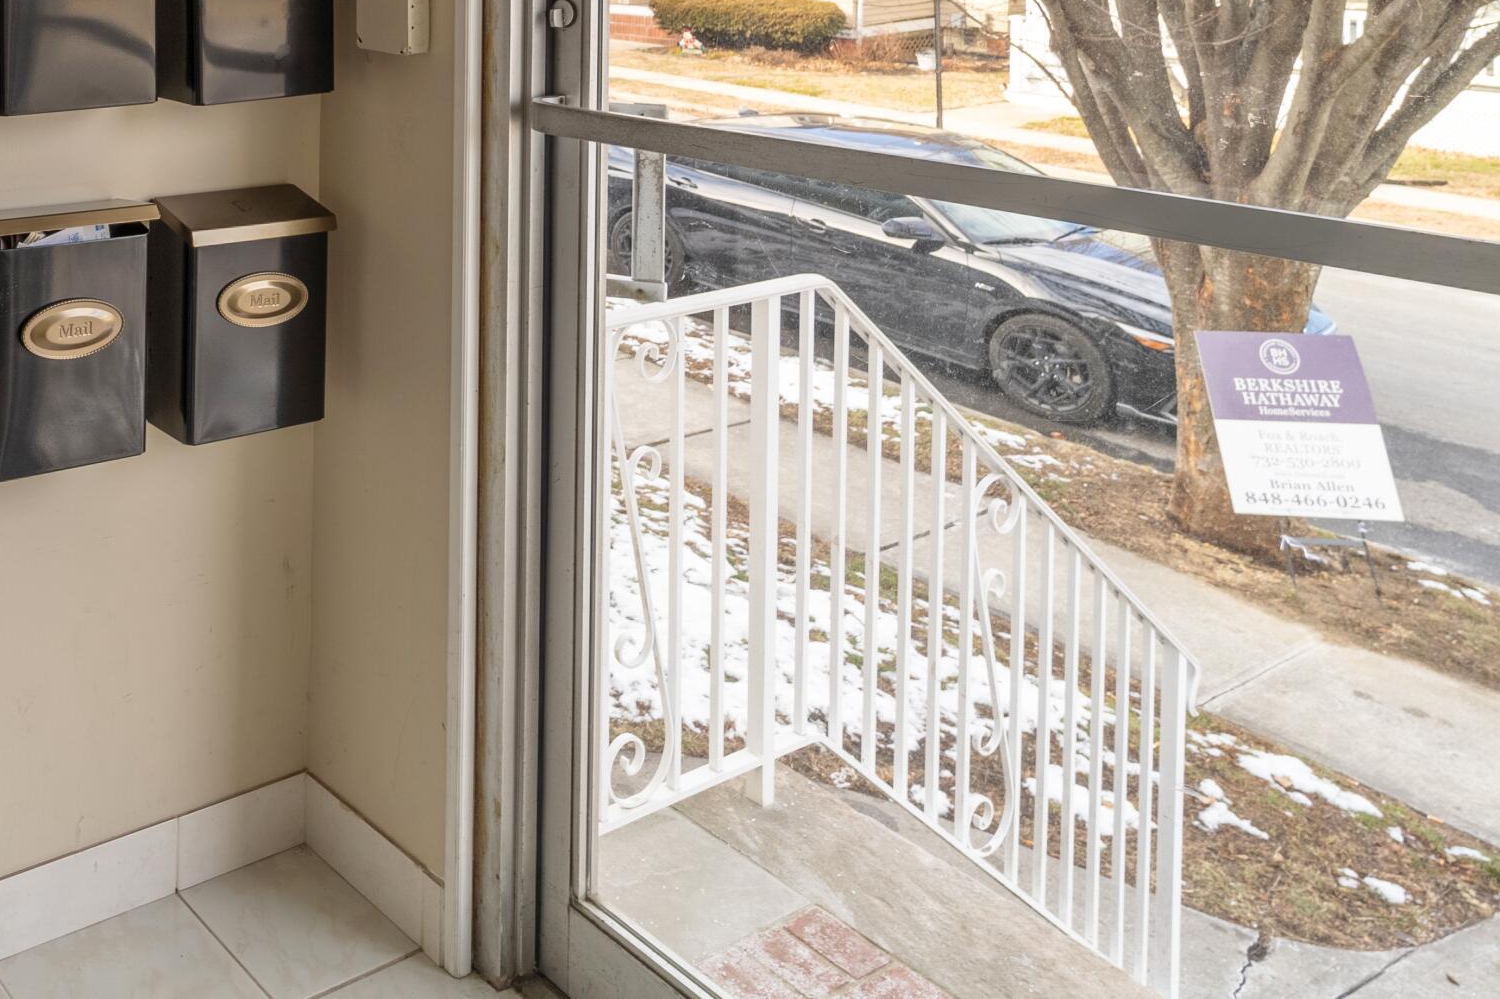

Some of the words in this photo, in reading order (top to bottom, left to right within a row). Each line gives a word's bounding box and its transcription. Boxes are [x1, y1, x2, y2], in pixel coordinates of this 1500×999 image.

[250, 291, 281, 309] Mail
[58, 320, 94, 339] Mail
[1233, 377, 1344, 394] BERKSHIRE
[1242, 391, 1341, 408] HATHAWAY
[1258, 405, 1331, 417] HomeServices
[1285, 430, 1295, 441] &
[1269, 479, 1312, 491] Brian
[1316, 480, 1356, 493] Allen
[1244, 491, 1387, 511] 848-466-0246
